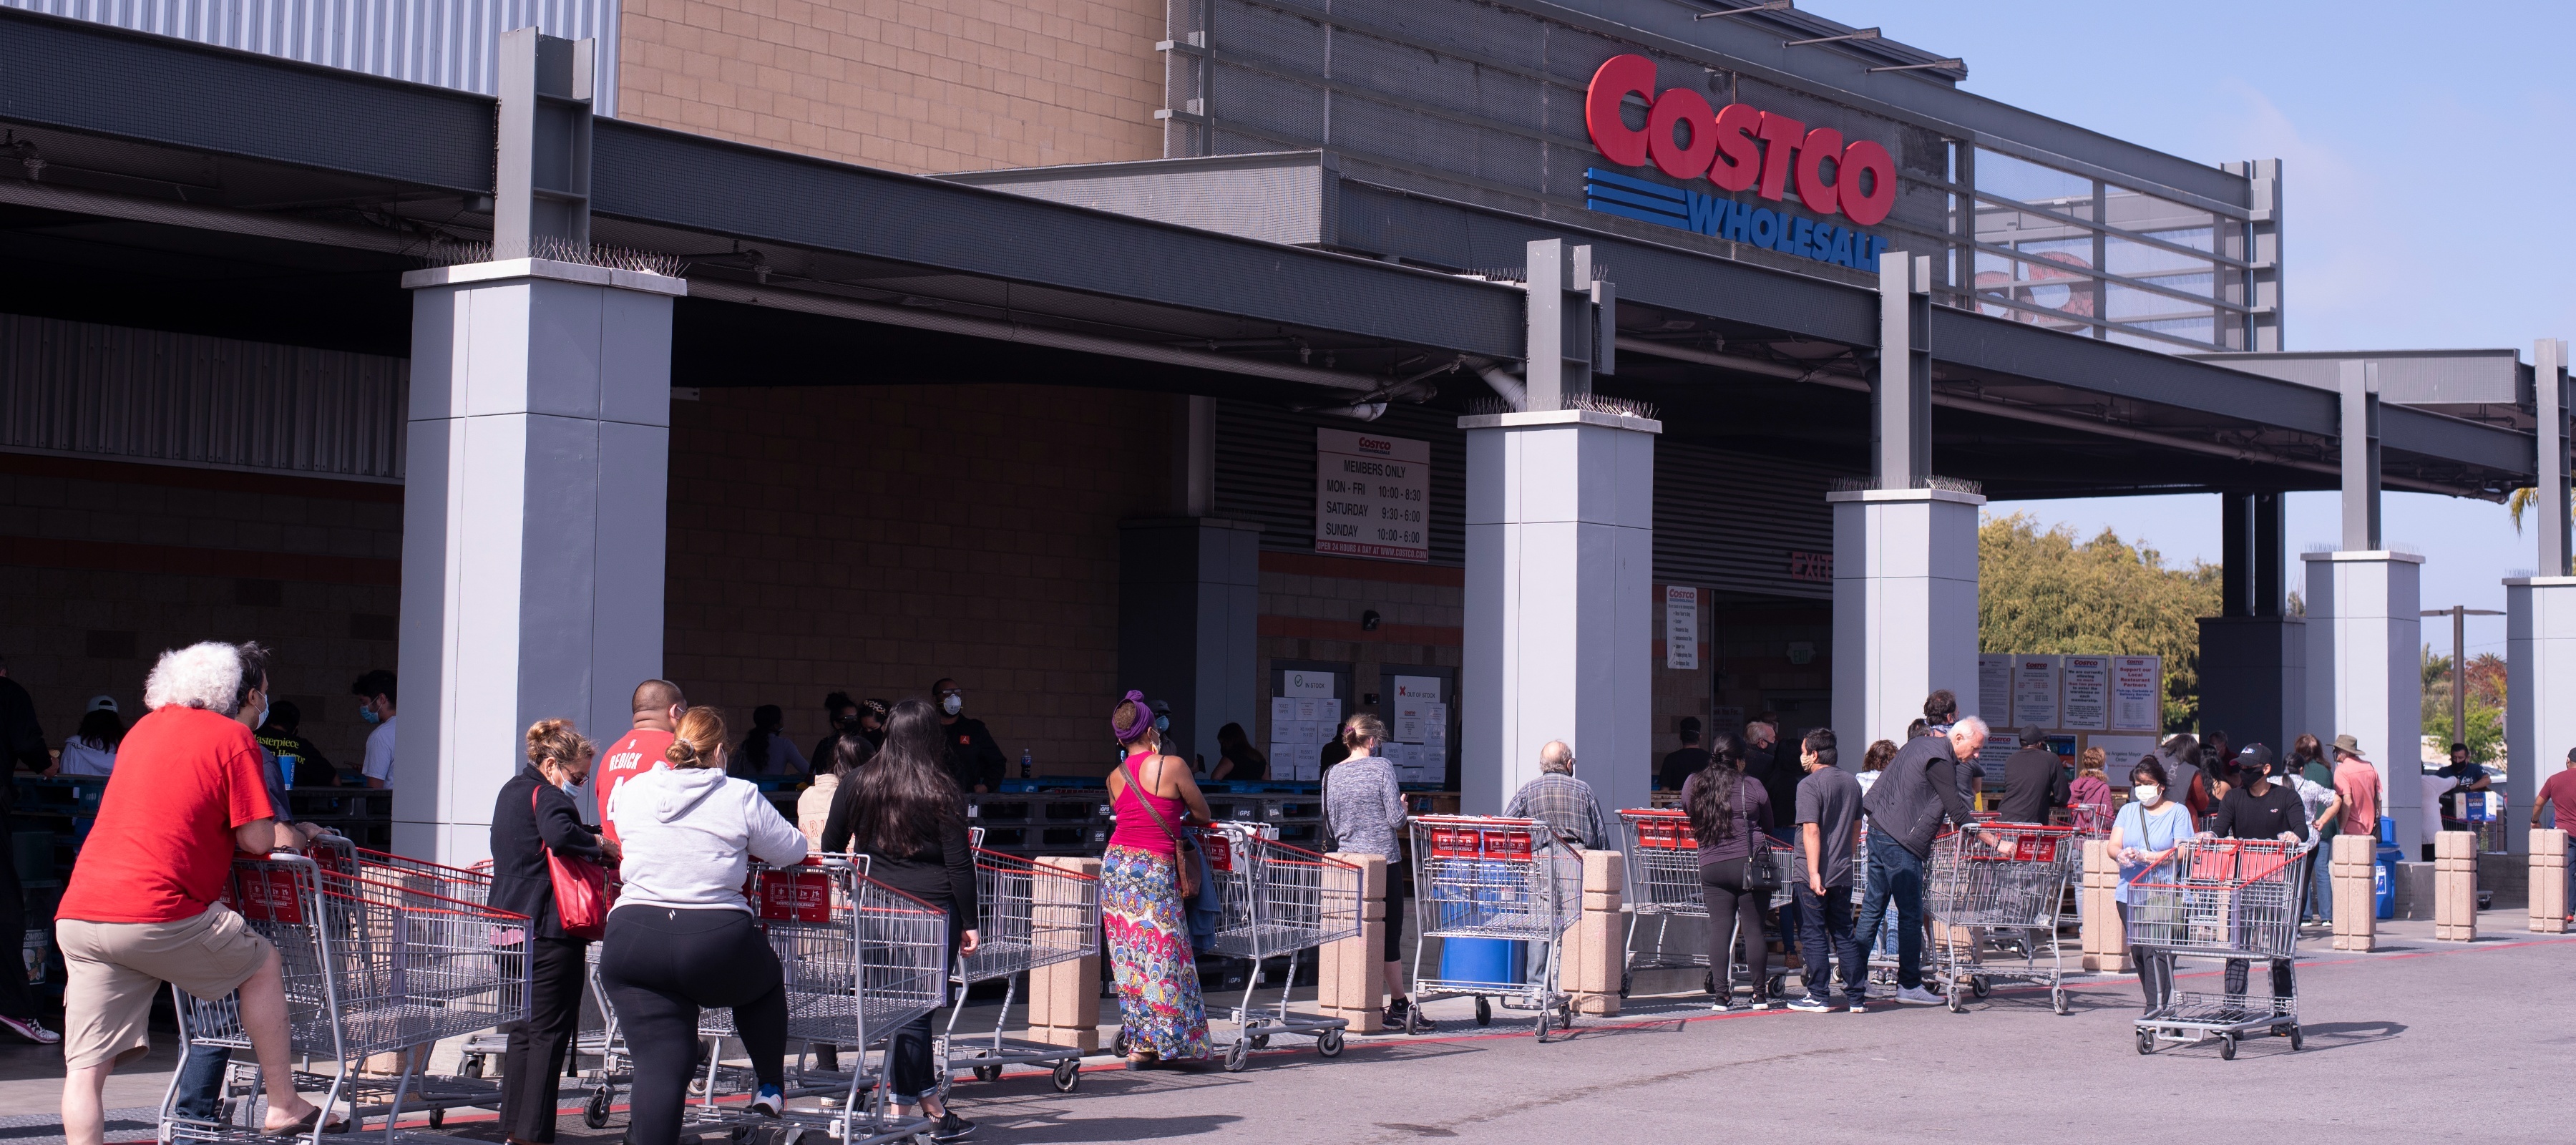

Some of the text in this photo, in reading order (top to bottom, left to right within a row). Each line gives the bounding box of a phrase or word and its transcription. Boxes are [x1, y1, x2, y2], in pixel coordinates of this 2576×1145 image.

[1586, 54, 1896, 225] COSTCO
[1685, 190, 1888, 274] WHOLESALE
[1359, 437, 1391, 450] COSTCO
[1344, 459, 1405, 478] MEMBERS ONLY
[1327, 479, 1345, 493] MON
[1353, 482, 1365, 495] FRI
[1378, 486, 1399, 499] 10:00
[1405, 489, 1421, 501] 8:30
[1326, 501, 1368, 517] SATURDAY
[1382, 507, 1398, 520] 9:30
[1405, 510, 1420, 523] 6:00
[1326, 522, 1358, 537] SUNDAY
[1377, 528, 1397, 541] 10:00
[1404, 531, 1420, 544] 6:00
[1317, 541, 1331, 550] OPEN
[1340, 543, 1356, 552] HOURS
[1357, 545, 1361, 553] A
[1362, 545, 1372, 554] DAY
[1381, 547, 1426, 559] WWW.COSTCO.COM
[1792, 551, 1833, 583] EXIT
[1669, 589, 1694, 599] COSTCO
[1793, 650, 1809, 663] EXIT
[609, 752, 643, 772] REDICK
